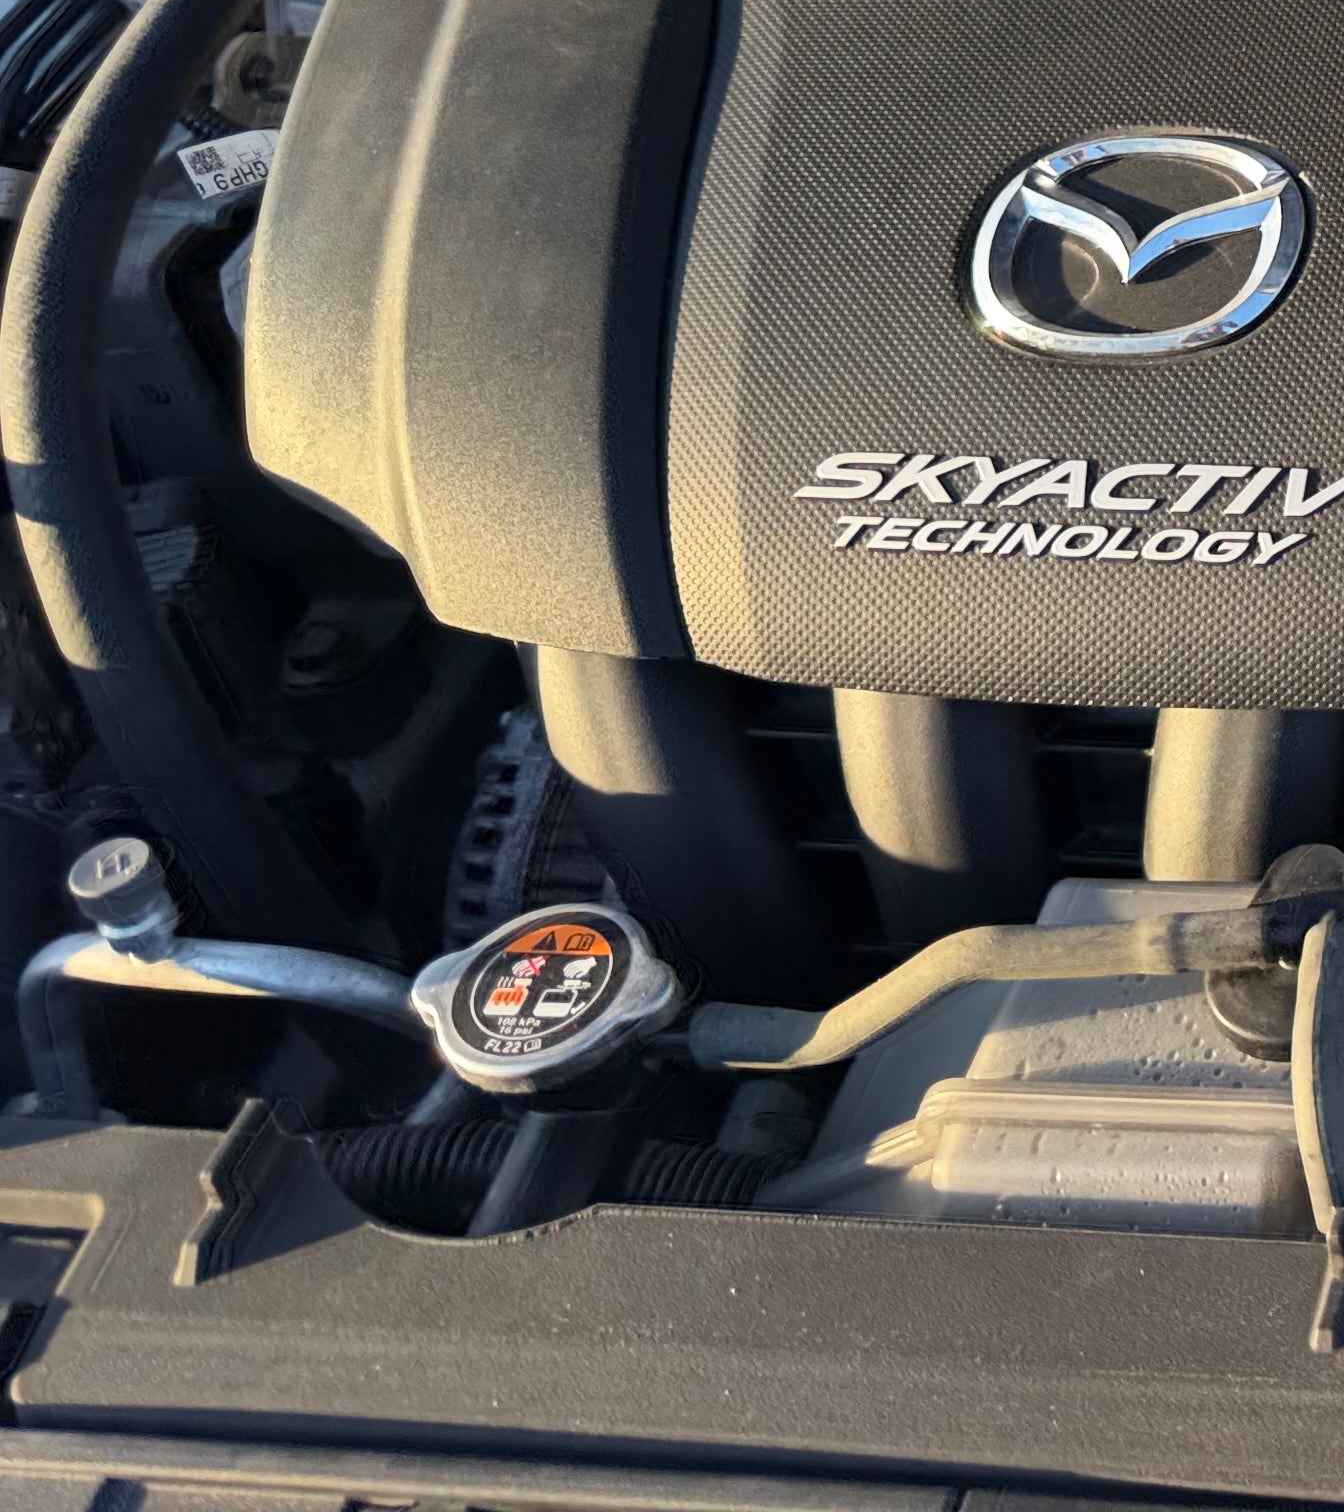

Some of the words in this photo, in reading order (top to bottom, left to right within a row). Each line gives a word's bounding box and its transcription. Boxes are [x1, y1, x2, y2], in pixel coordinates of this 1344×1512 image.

[213, 160, 269, 191] GHP9
[833, 515, 1308, 566] TECHNOLOGY
[518, 1017, 541, 1027] kPa
[500, 1025, 512, 1035] 16
[513, 1027, 534, 1036] psi
[484, 1038, 522, 1054] FL22
